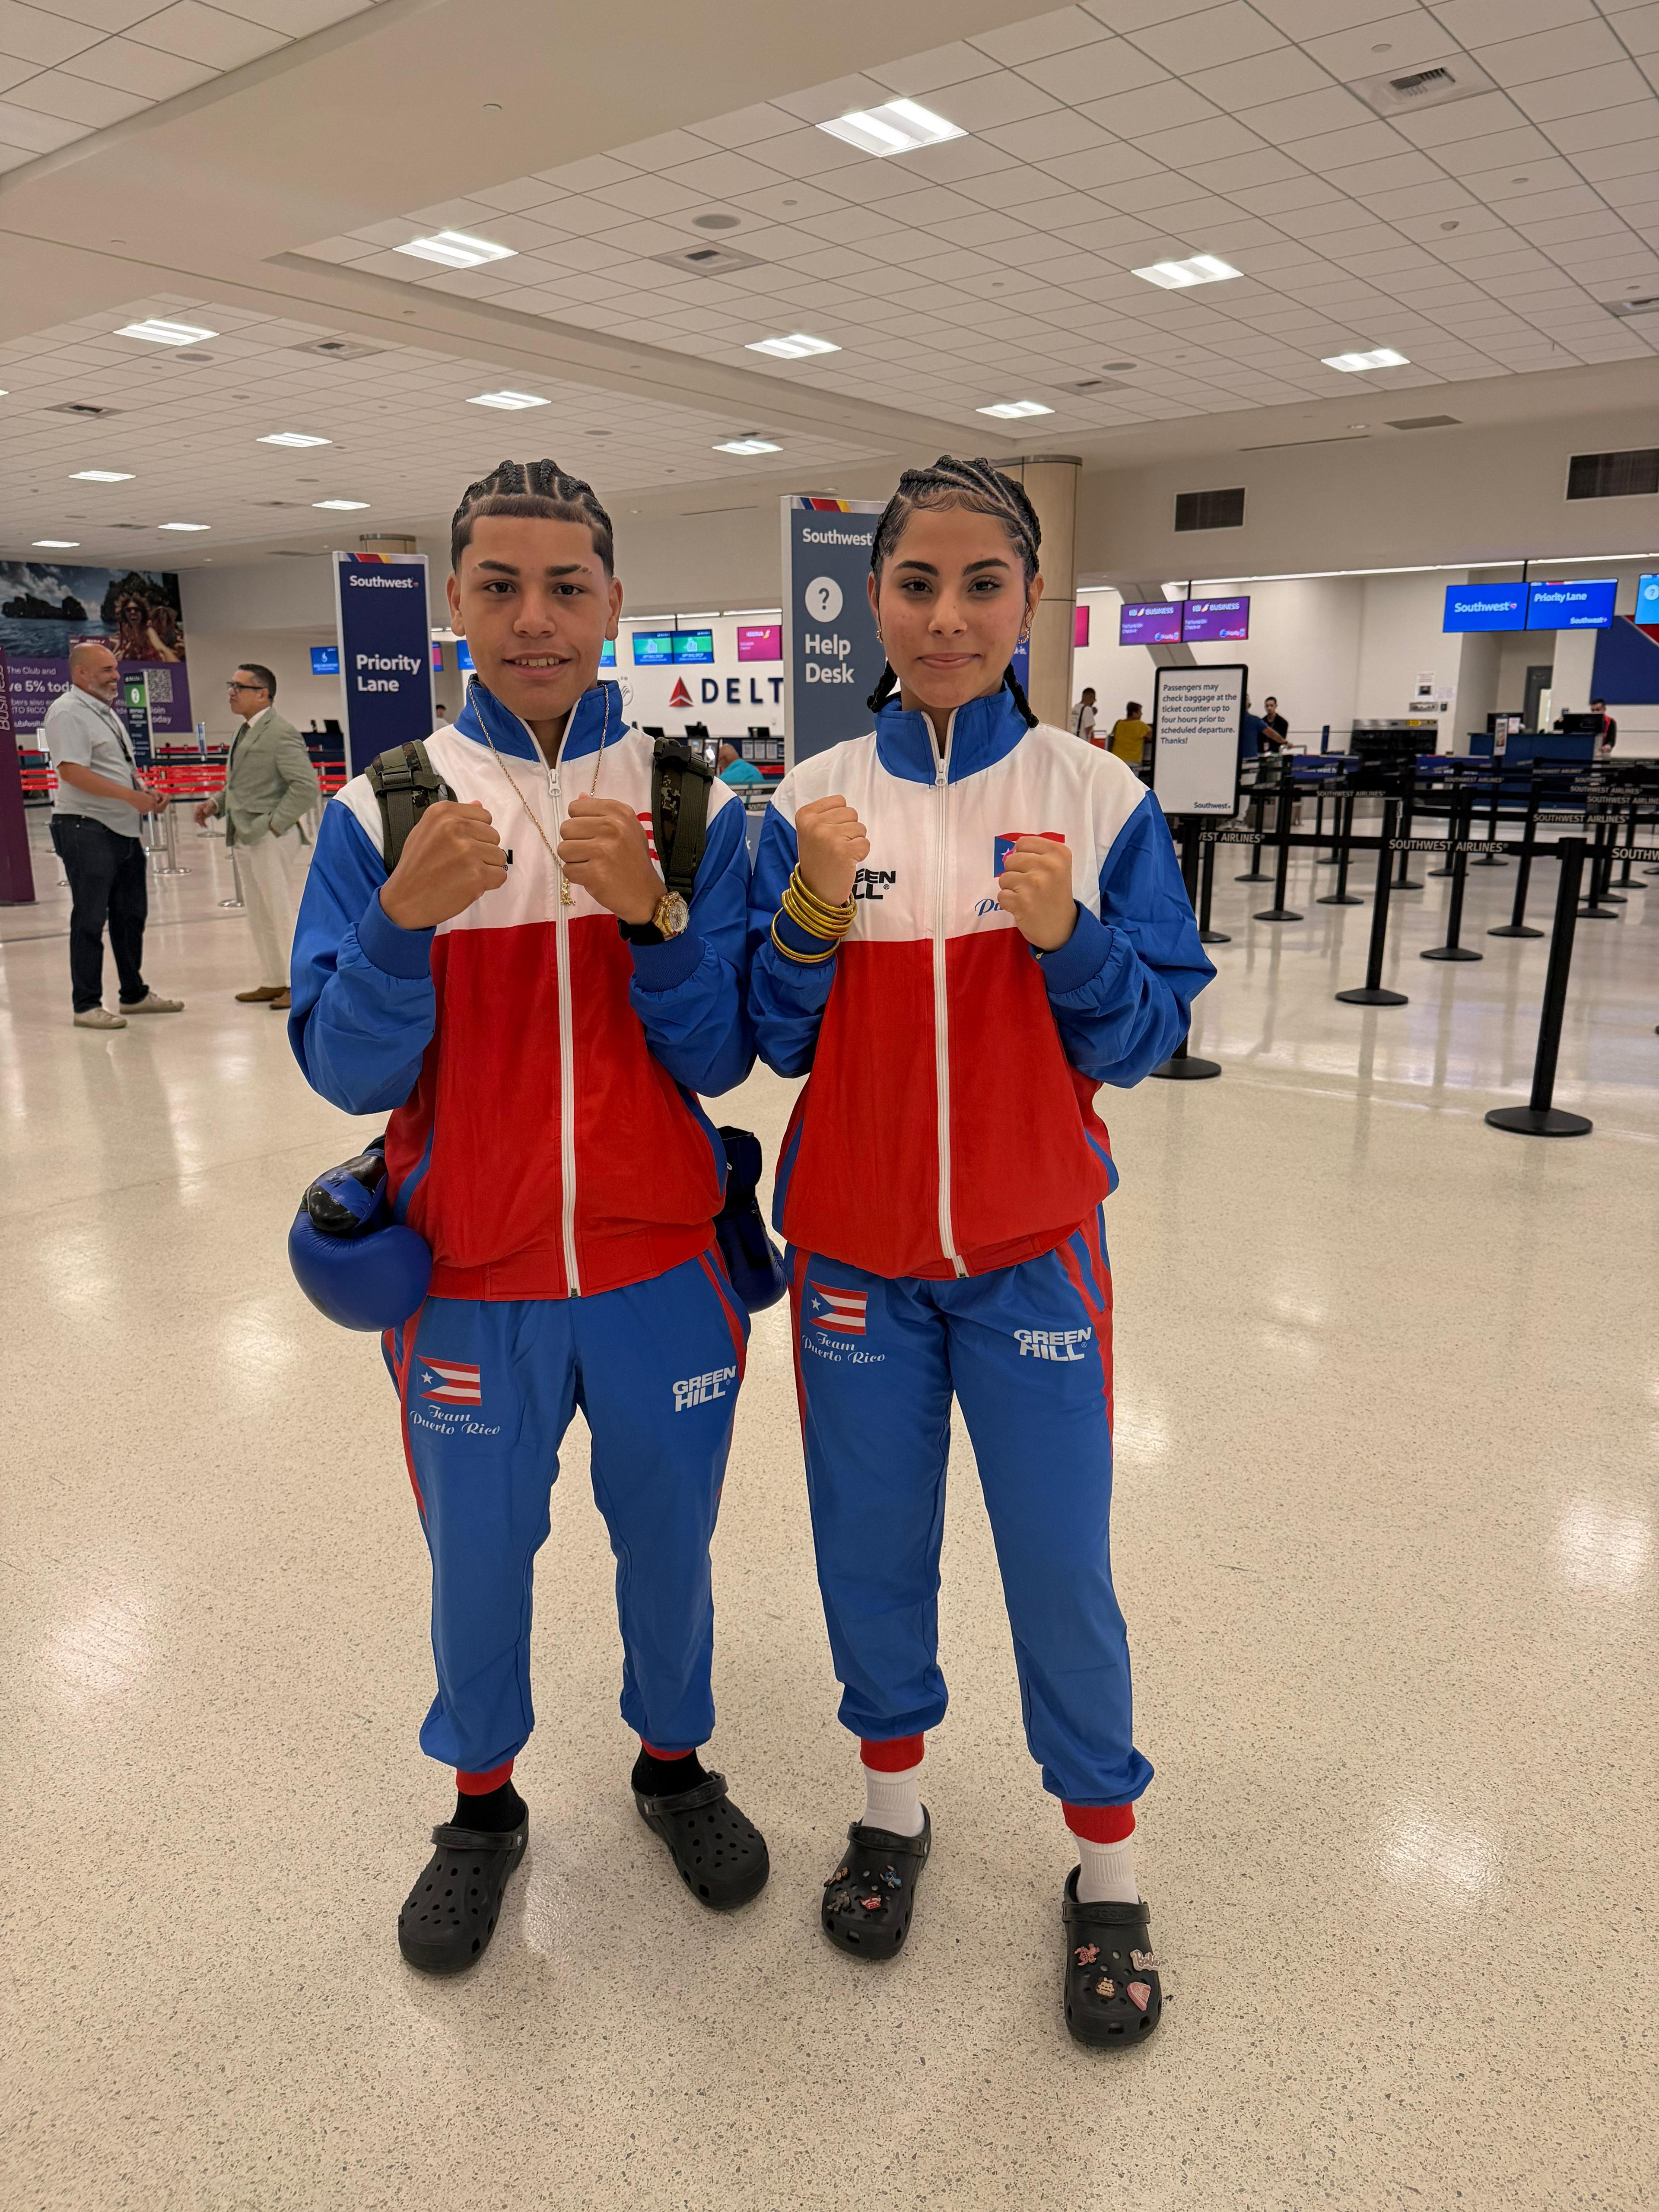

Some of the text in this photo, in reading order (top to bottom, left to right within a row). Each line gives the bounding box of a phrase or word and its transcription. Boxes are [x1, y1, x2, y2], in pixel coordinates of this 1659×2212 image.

[802, 528, 872, 546] Southwest
[350, 575, 413, 588] Southwest
[818, 588, 830, 610] ?
[1534, 592, 1587, 604] Priority Lane
[1145, 607, 1174, 615] BUSINESS
[1209, 602, 1240, 611] BUSINESS
[1454, 601, 1509, 613] Southwest
[1570, 616, 1603, 625] Southwest
[805, 634, 851, 661] Help
[7, 665, 22, 674] The
[22, 666, 41, 675] Club
[356, 654, 421, 675] Priority
[805, 663, 854, 683] Desk
[25, 680, 45, 692] 5%
[357, 676, 399, 692] Lane
[702, 677, 783, 704] DELT
[1184, 695, 1214, 703] baggage
[1198, 715, 1216, 724] prior
[1570, 785, 1640, 795] SOUTHWEST AIRLINES
[1586, 795, 1631, 804] SOUTHWEST
[1533, 813, 1627, 823] SOUTHWEST AIRLINES
[1220, 833, 1261, 843] AIRLINES
[1389, 838, 1503, 852] SOUTHWEST AIRLINES
[816, 1332, 857, 1351] Team
[1014, 1327, 1092, 1346] GREEN
[802, 1335, 885, 1363] Puerto Rico
[1020, 1341, 1085, 1362] HILL
[672, 1365, 736, 1395] GREEN
[675, 1382, 726, 1412] HILL
[429, 1405, 471, 1421] Team
[410, 1410, 500, 1435] Puerto Rico
